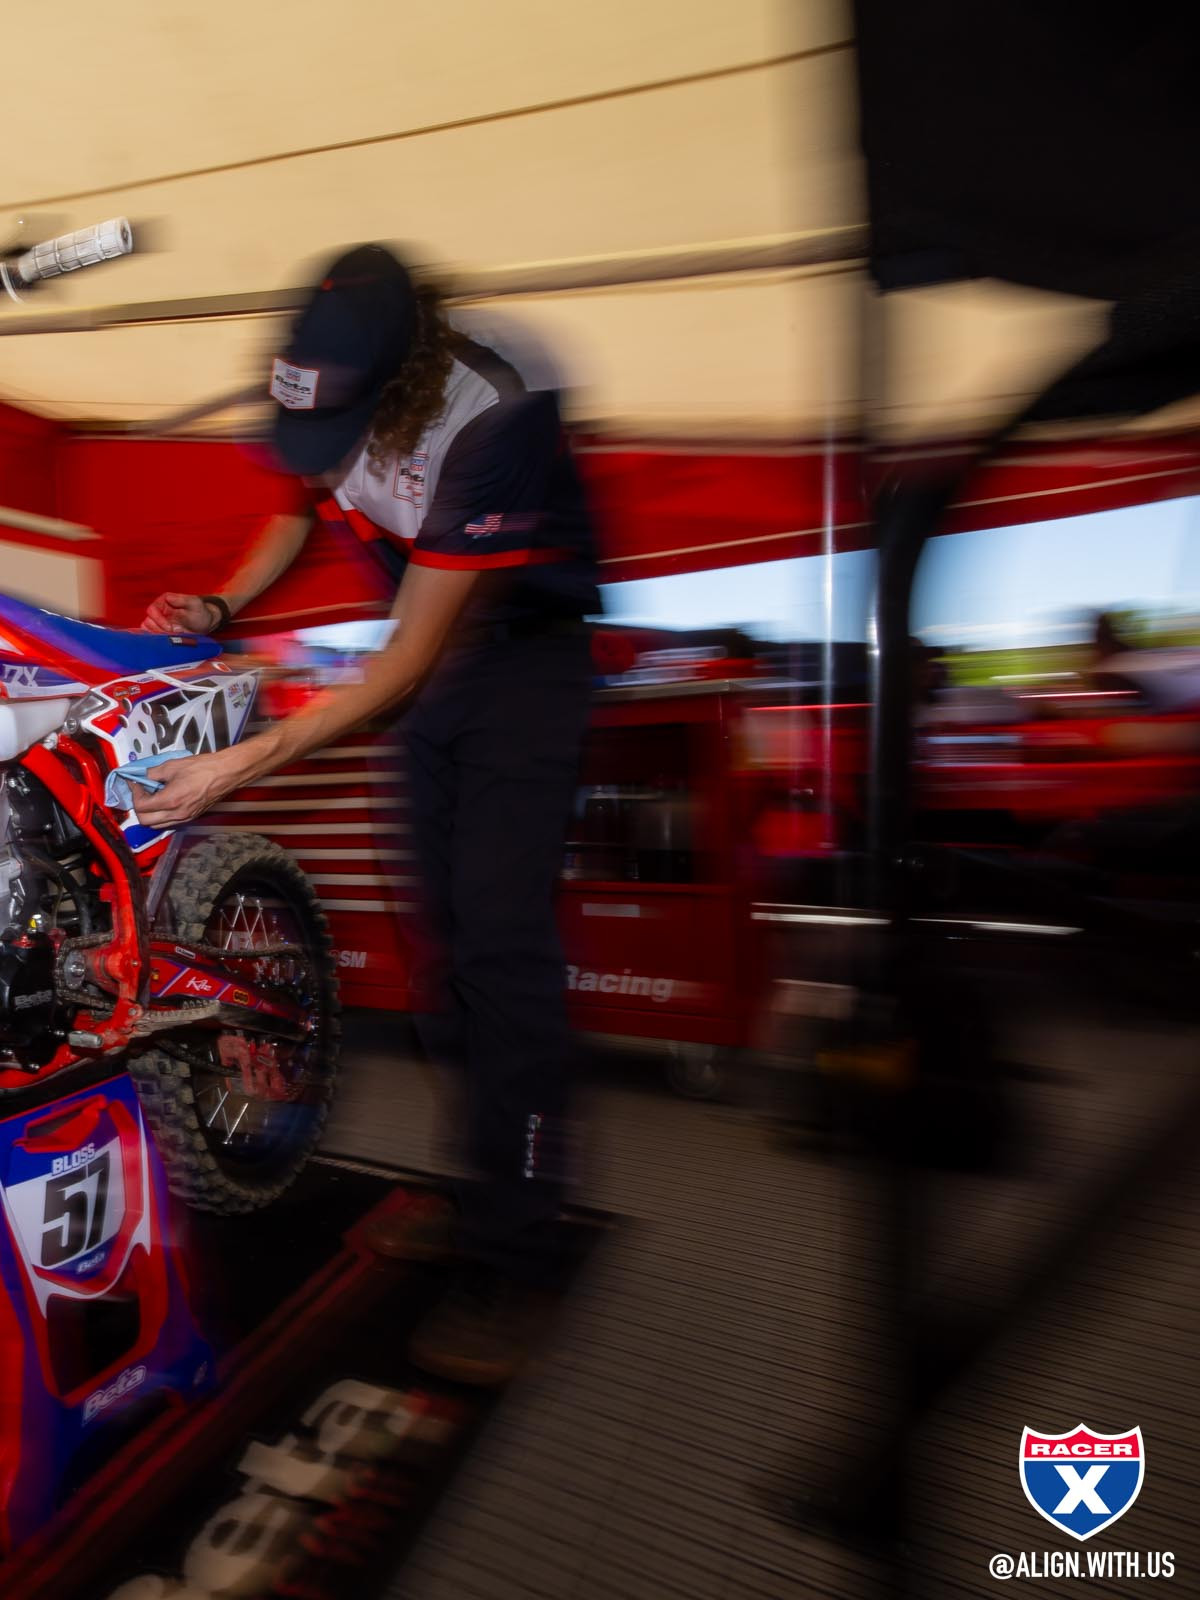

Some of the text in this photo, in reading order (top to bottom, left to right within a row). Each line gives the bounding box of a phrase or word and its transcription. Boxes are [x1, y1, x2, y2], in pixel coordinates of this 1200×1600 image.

[52, 1142, 96, 1176] BLOSS
[41, 1150, 111, 1267] 57
[82, 1365, 147, 1427] Beta
